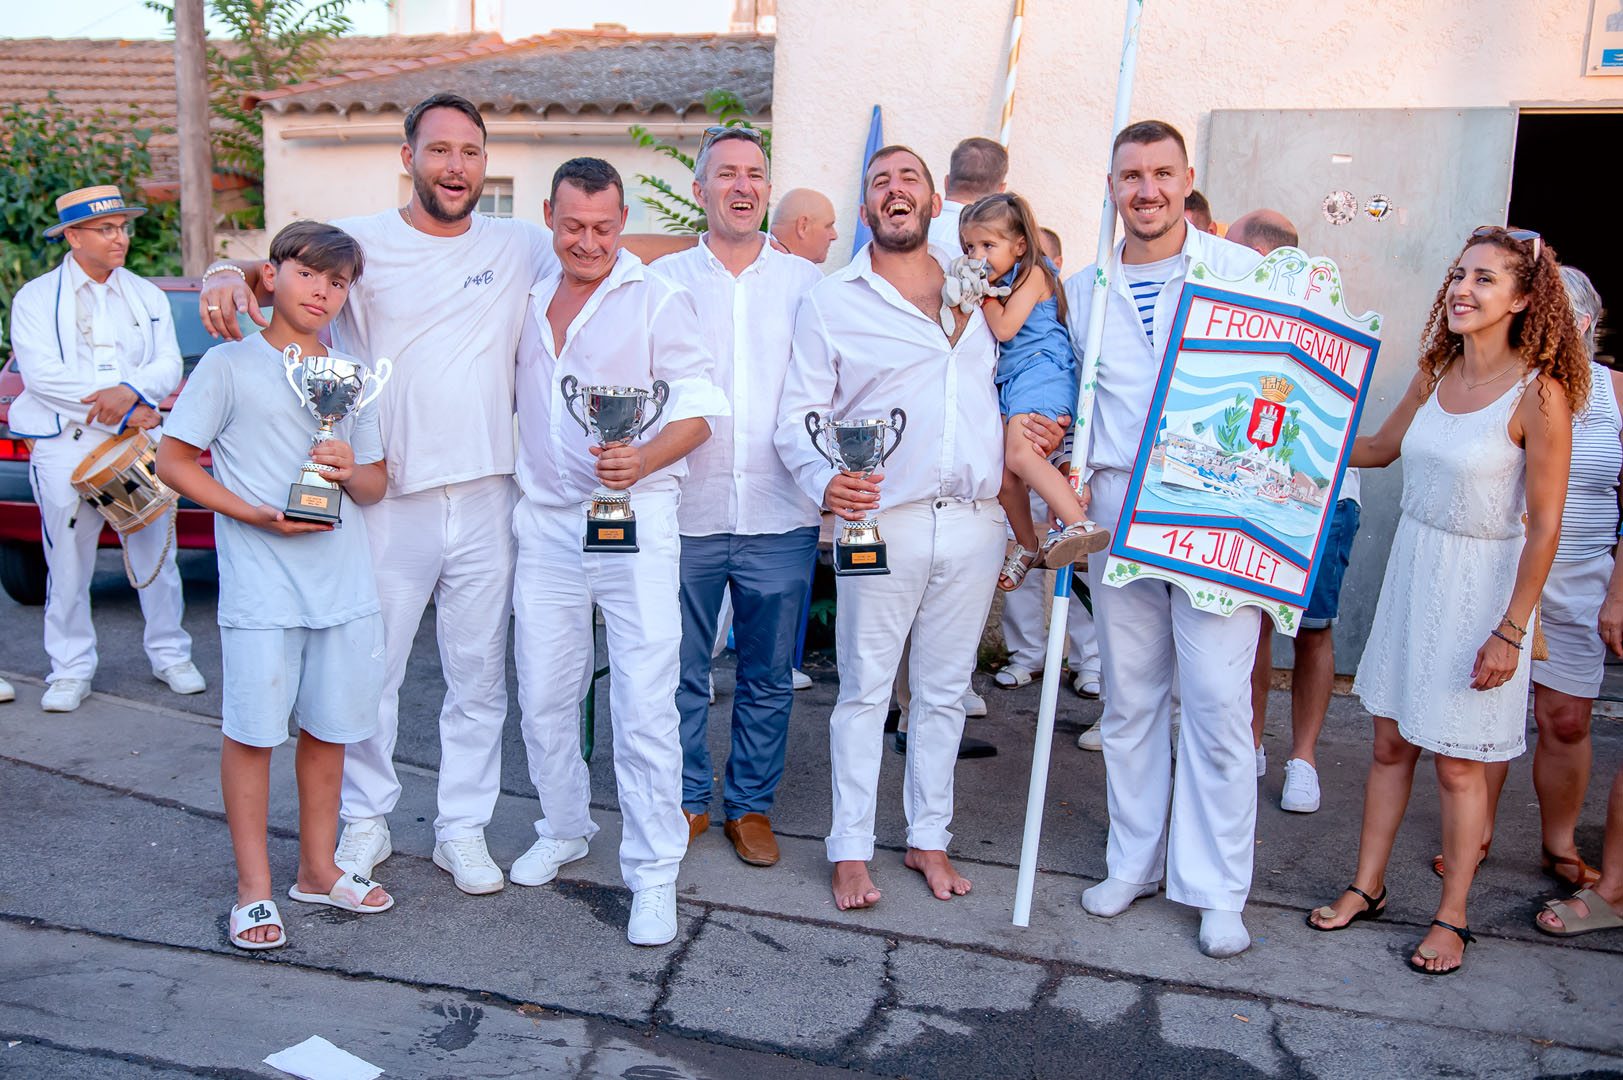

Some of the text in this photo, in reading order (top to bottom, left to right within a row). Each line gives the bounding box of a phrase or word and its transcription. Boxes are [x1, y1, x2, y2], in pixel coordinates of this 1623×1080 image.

[87, 198, 125, 214] TAMB
[1205, 304, 1351, 377] FRONTIGNAN
[1162, 529, 1281, 584] 14 JUILLET
